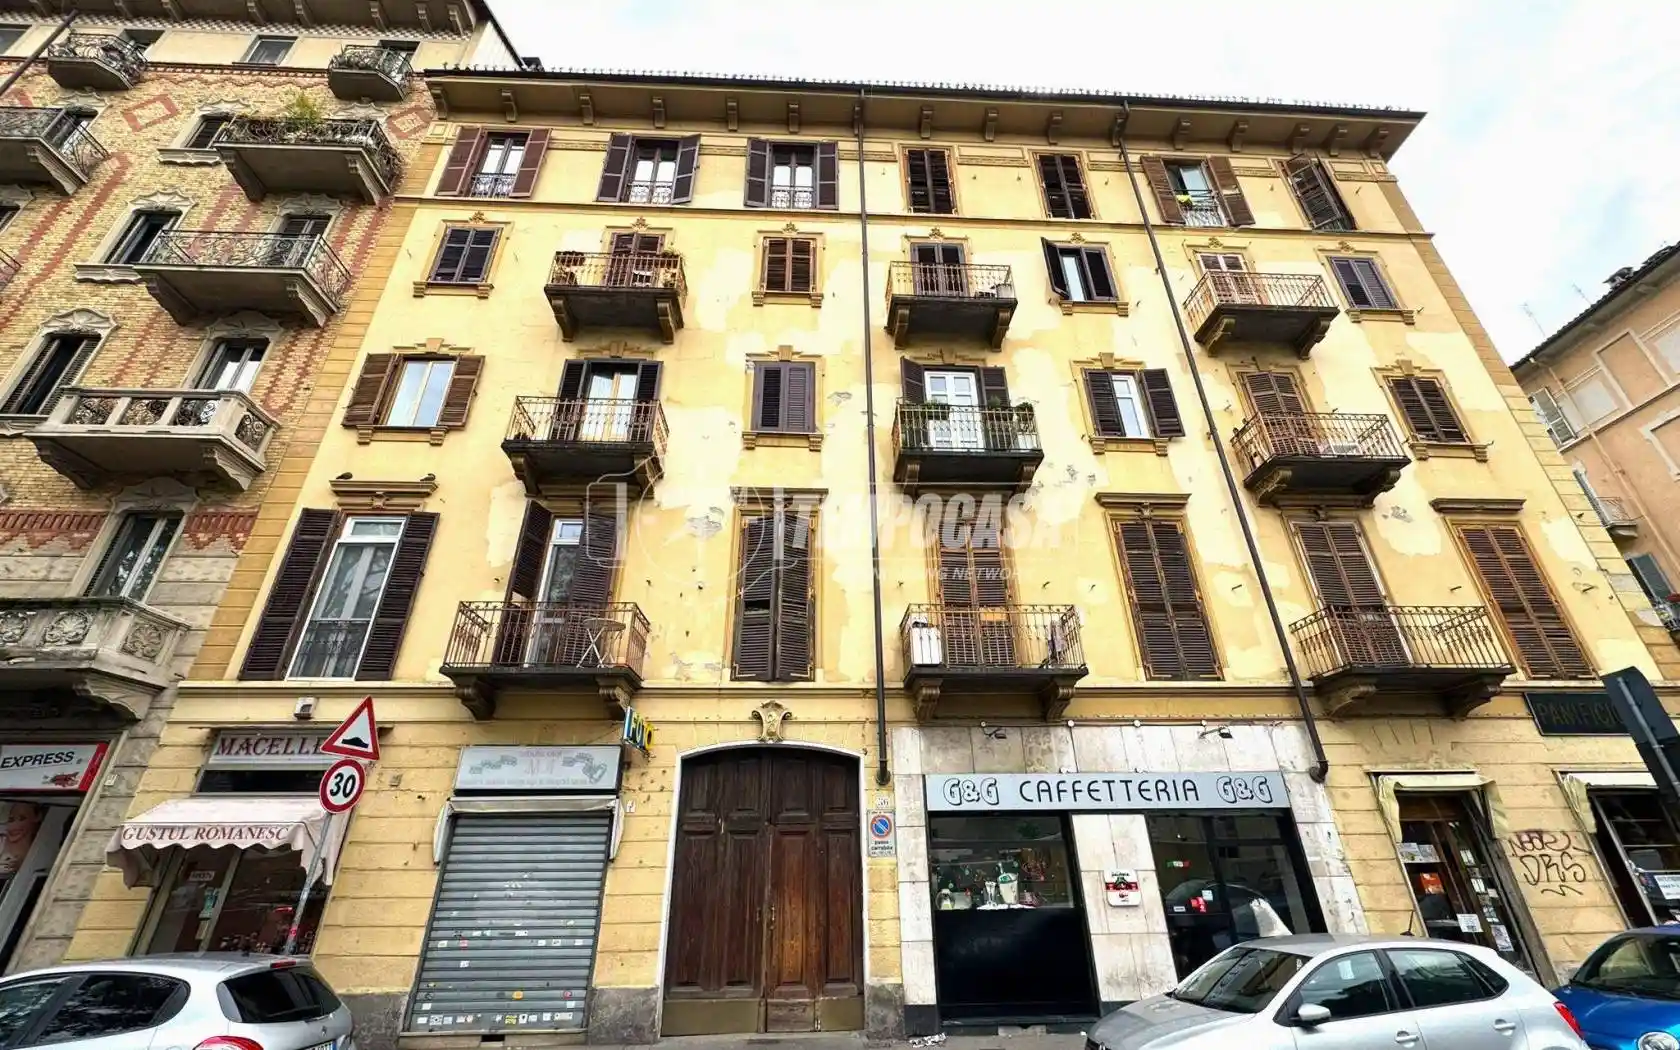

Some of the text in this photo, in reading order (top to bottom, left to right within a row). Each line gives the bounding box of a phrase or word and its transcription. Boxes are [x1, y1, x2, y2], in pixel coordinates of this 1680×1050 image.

[1, 751, 75, 769] EXPRESS
[329, 772, 357, 798] 30
[943, 776, 1273, 806] G&G CAFFETTERIA G&G
[122, 826, 288, 841] GUSTUL ROMANESC
[1519, 851, 1586, 886] DRS
